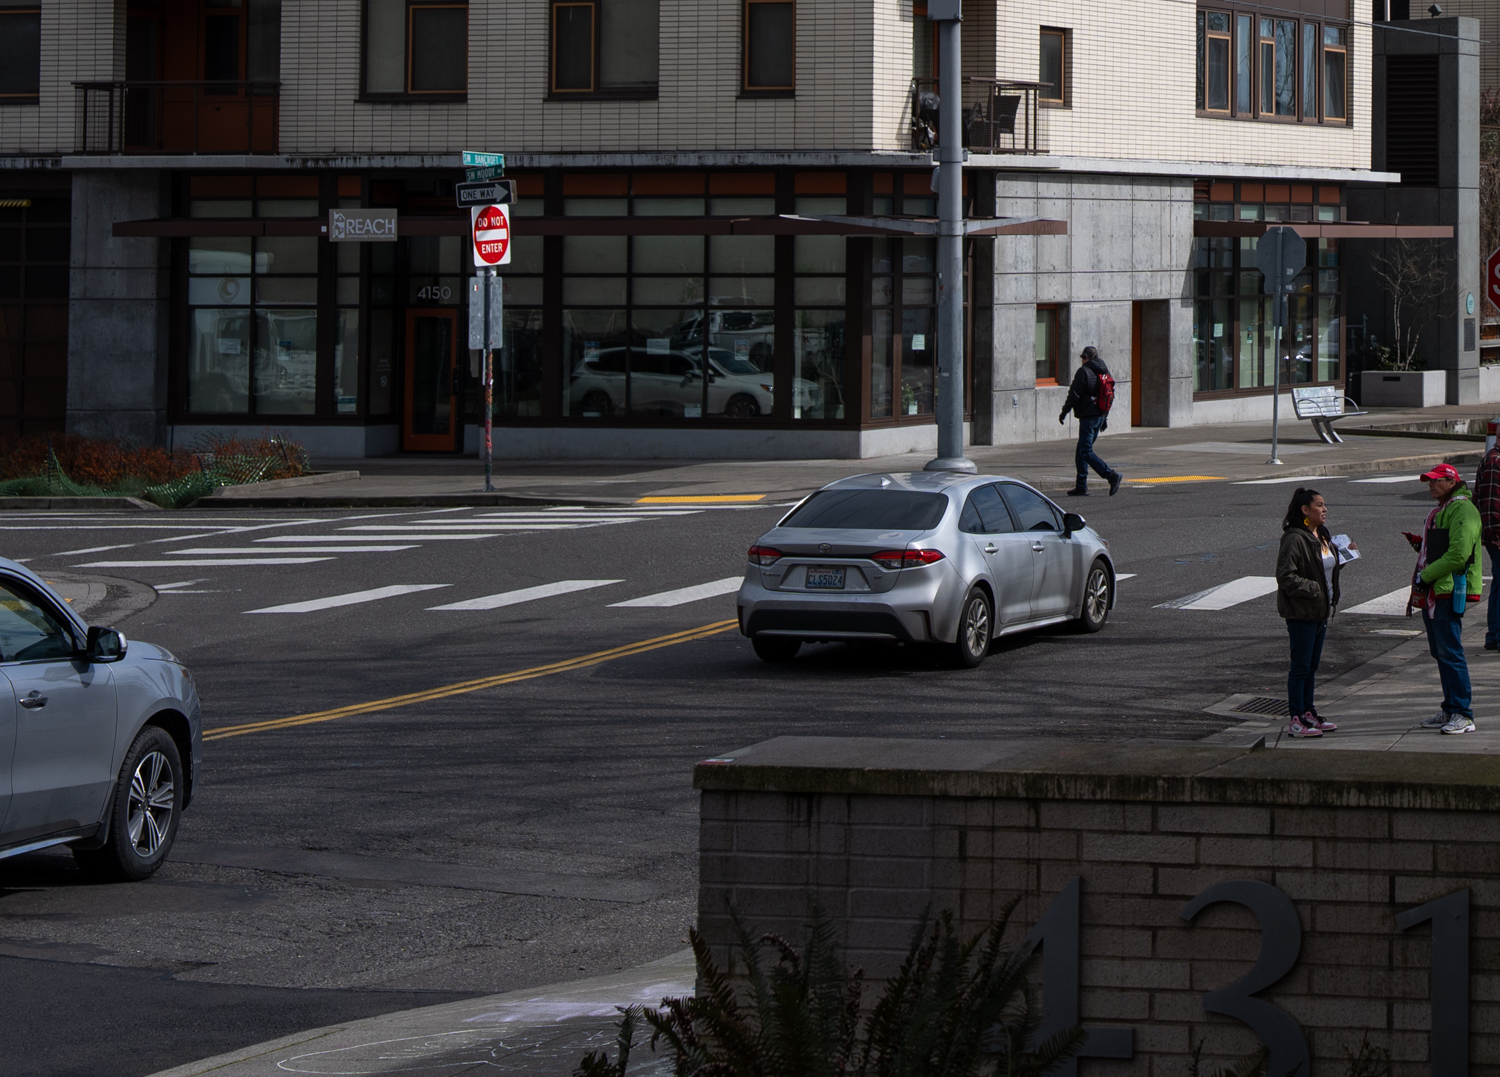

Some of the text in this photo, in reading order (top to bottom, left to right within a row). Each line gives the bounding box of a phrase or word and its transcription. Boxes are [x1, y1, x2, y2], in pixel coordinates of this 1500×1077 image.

[475, 155, 499, 165] BANCROFT
[467, 171, 475, 180] SW
[477, 167, 495, 179] MOODY
[463, 188, 494, 200] ONE WAY
[346, 218, 395, 234] REACH
[478, 216, 504, 227] DO NOT
[481, 242, 503, 254] ENTER
[417, 286, 452, 300] 4150
[807, 574, 843, 586] CLS5024
